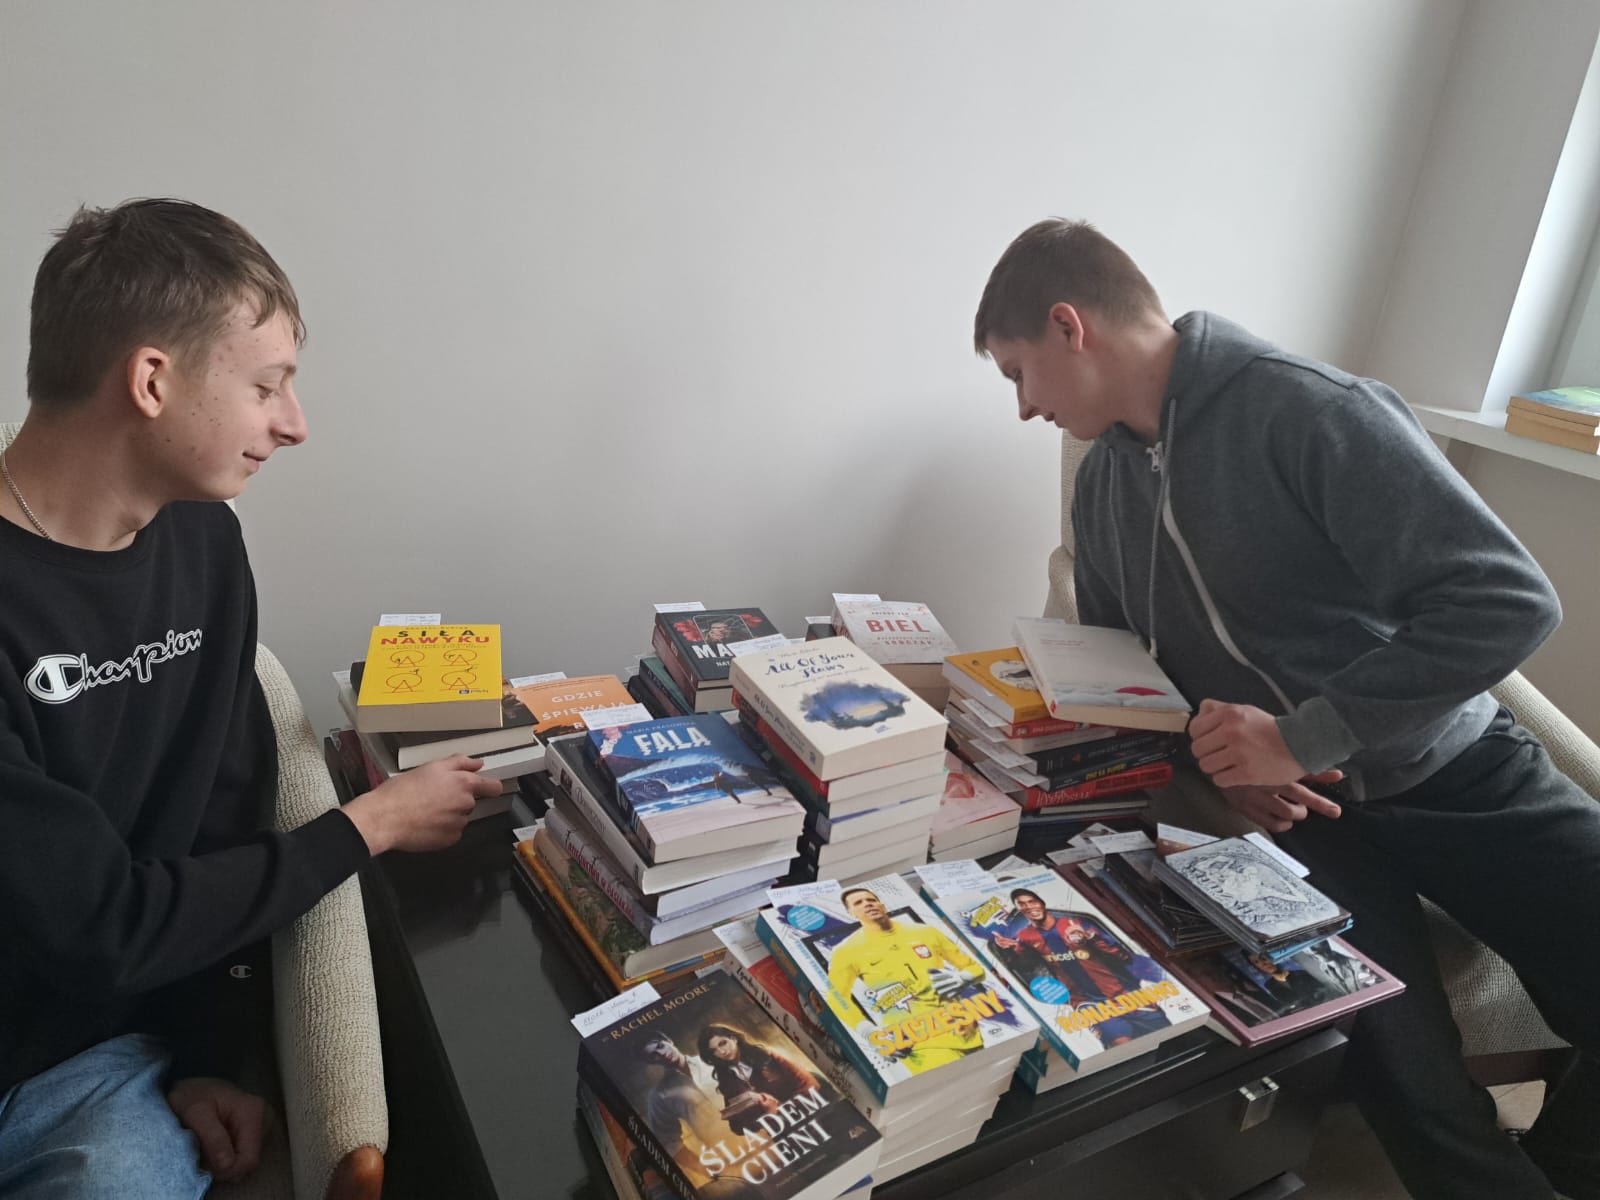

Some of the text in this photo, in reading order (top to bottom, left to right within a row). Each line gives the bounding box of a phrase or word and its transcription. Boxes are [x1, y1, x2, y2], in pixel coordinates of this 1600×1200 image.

[381, 636, 490, 645] NAWYKU
[866, 619, 931, 633] BIEL
[23, 628, 203, 705] Champion
[765, 663, 796, 675] All
[551, 690, 604, 703] GDZIE
[633, 727, 712, 756] FALA
[610, 1008, 663, 1040] RACHEL
[663, 983, 711, 1012] MOORE
[1056, 979, 1181, 1035] RONALDINHO
[699, 1086, 830, 1178] ŚLADEM
[741, 1119, 832, 1185] CIENI
